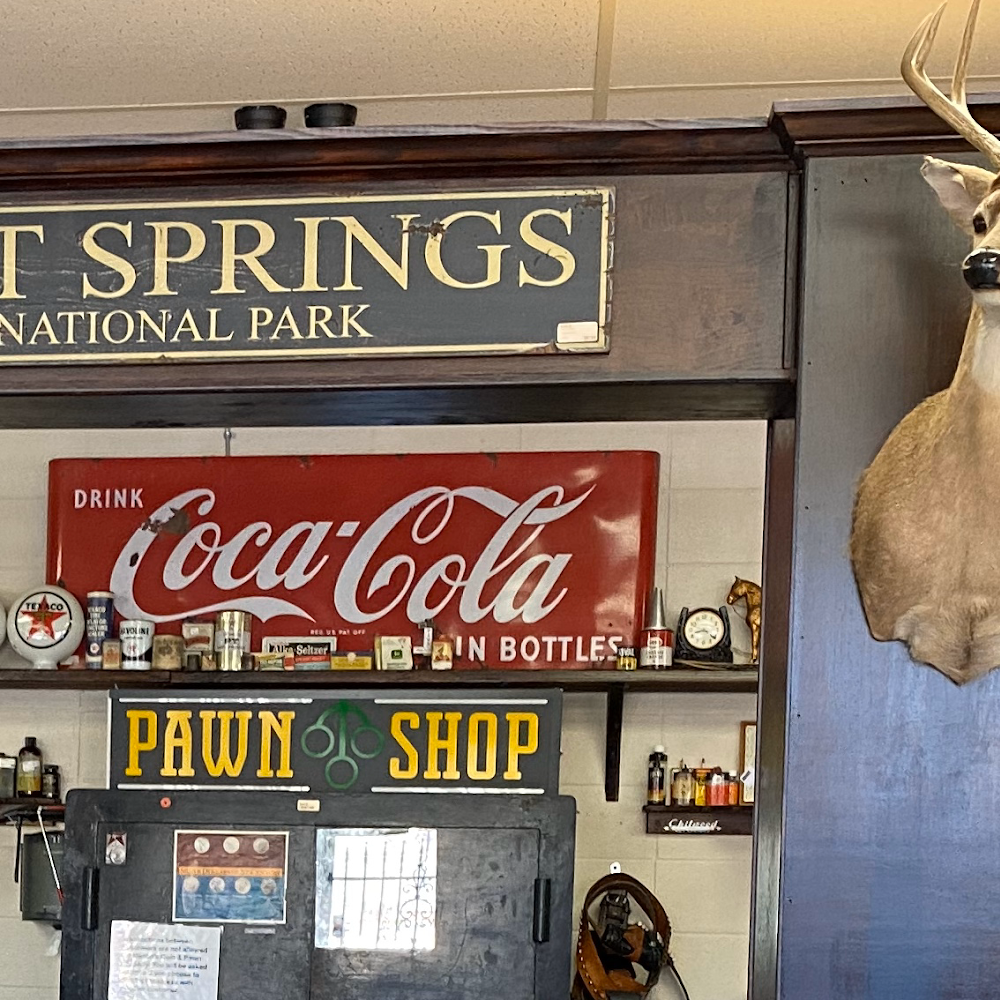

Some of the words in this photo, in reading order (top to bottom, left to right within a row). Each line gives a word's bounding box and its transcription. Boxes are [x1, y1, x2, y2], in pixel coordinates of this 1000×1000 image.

[82, 207, 577, 300] SPRINGS
[248, 304, 374, 341] PARK
[74, 487, 145, 510] DRINK
[109, 484, 597, 624] Coca-Cola
[456, 635, 487, 661] IN
[499, 635, 623, 663] BOTTLES
[124, 709, 296, 778] PAWN
[388, 711, 539, 781] SHOP
